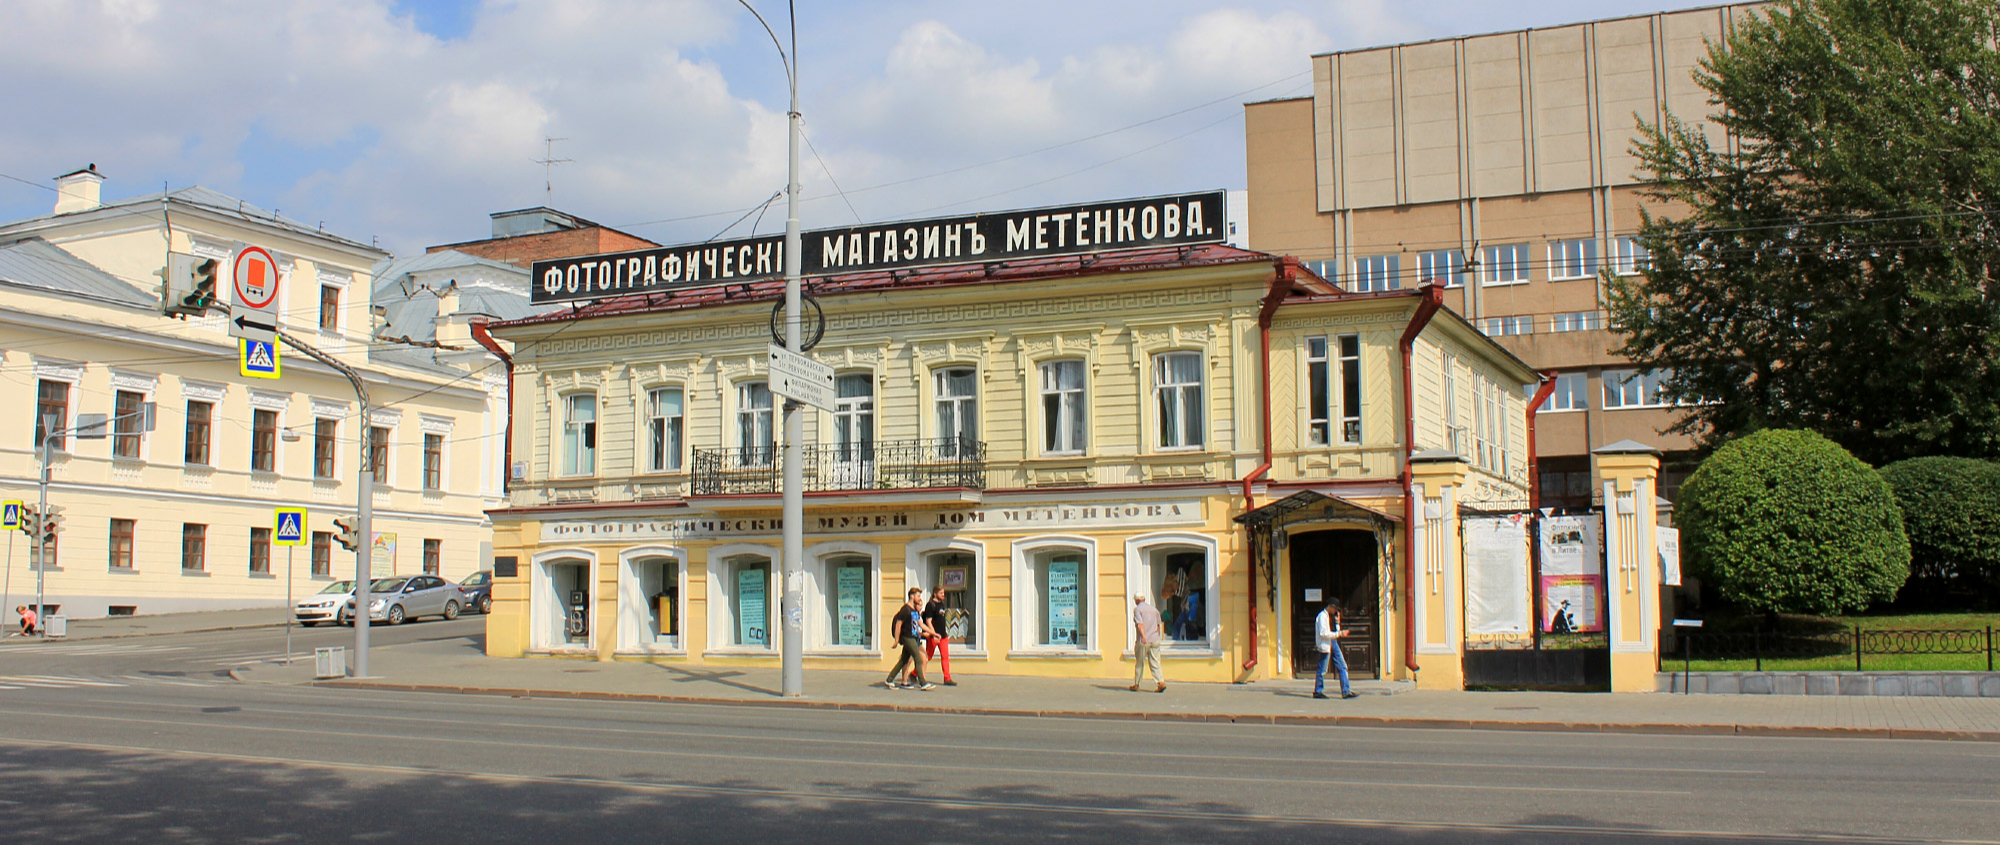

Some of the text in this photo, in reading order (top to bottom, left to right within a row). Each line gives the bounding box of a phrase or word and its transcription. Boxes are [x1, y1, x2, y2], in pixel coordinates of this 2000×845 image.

[544, 200, 1213, 296] ФОТОГРАФИЧЕСКІ МАГАЗИНЪ МЕТЕНКОВА.
[788, 354, 824, 373] ПЕРВОМАЙСКАЯ
[553, 504, 1182, 535] ФОТОГРАФИЧЕСКИ МУЗЕЙ ДОМ МЕТЕНКОВА
